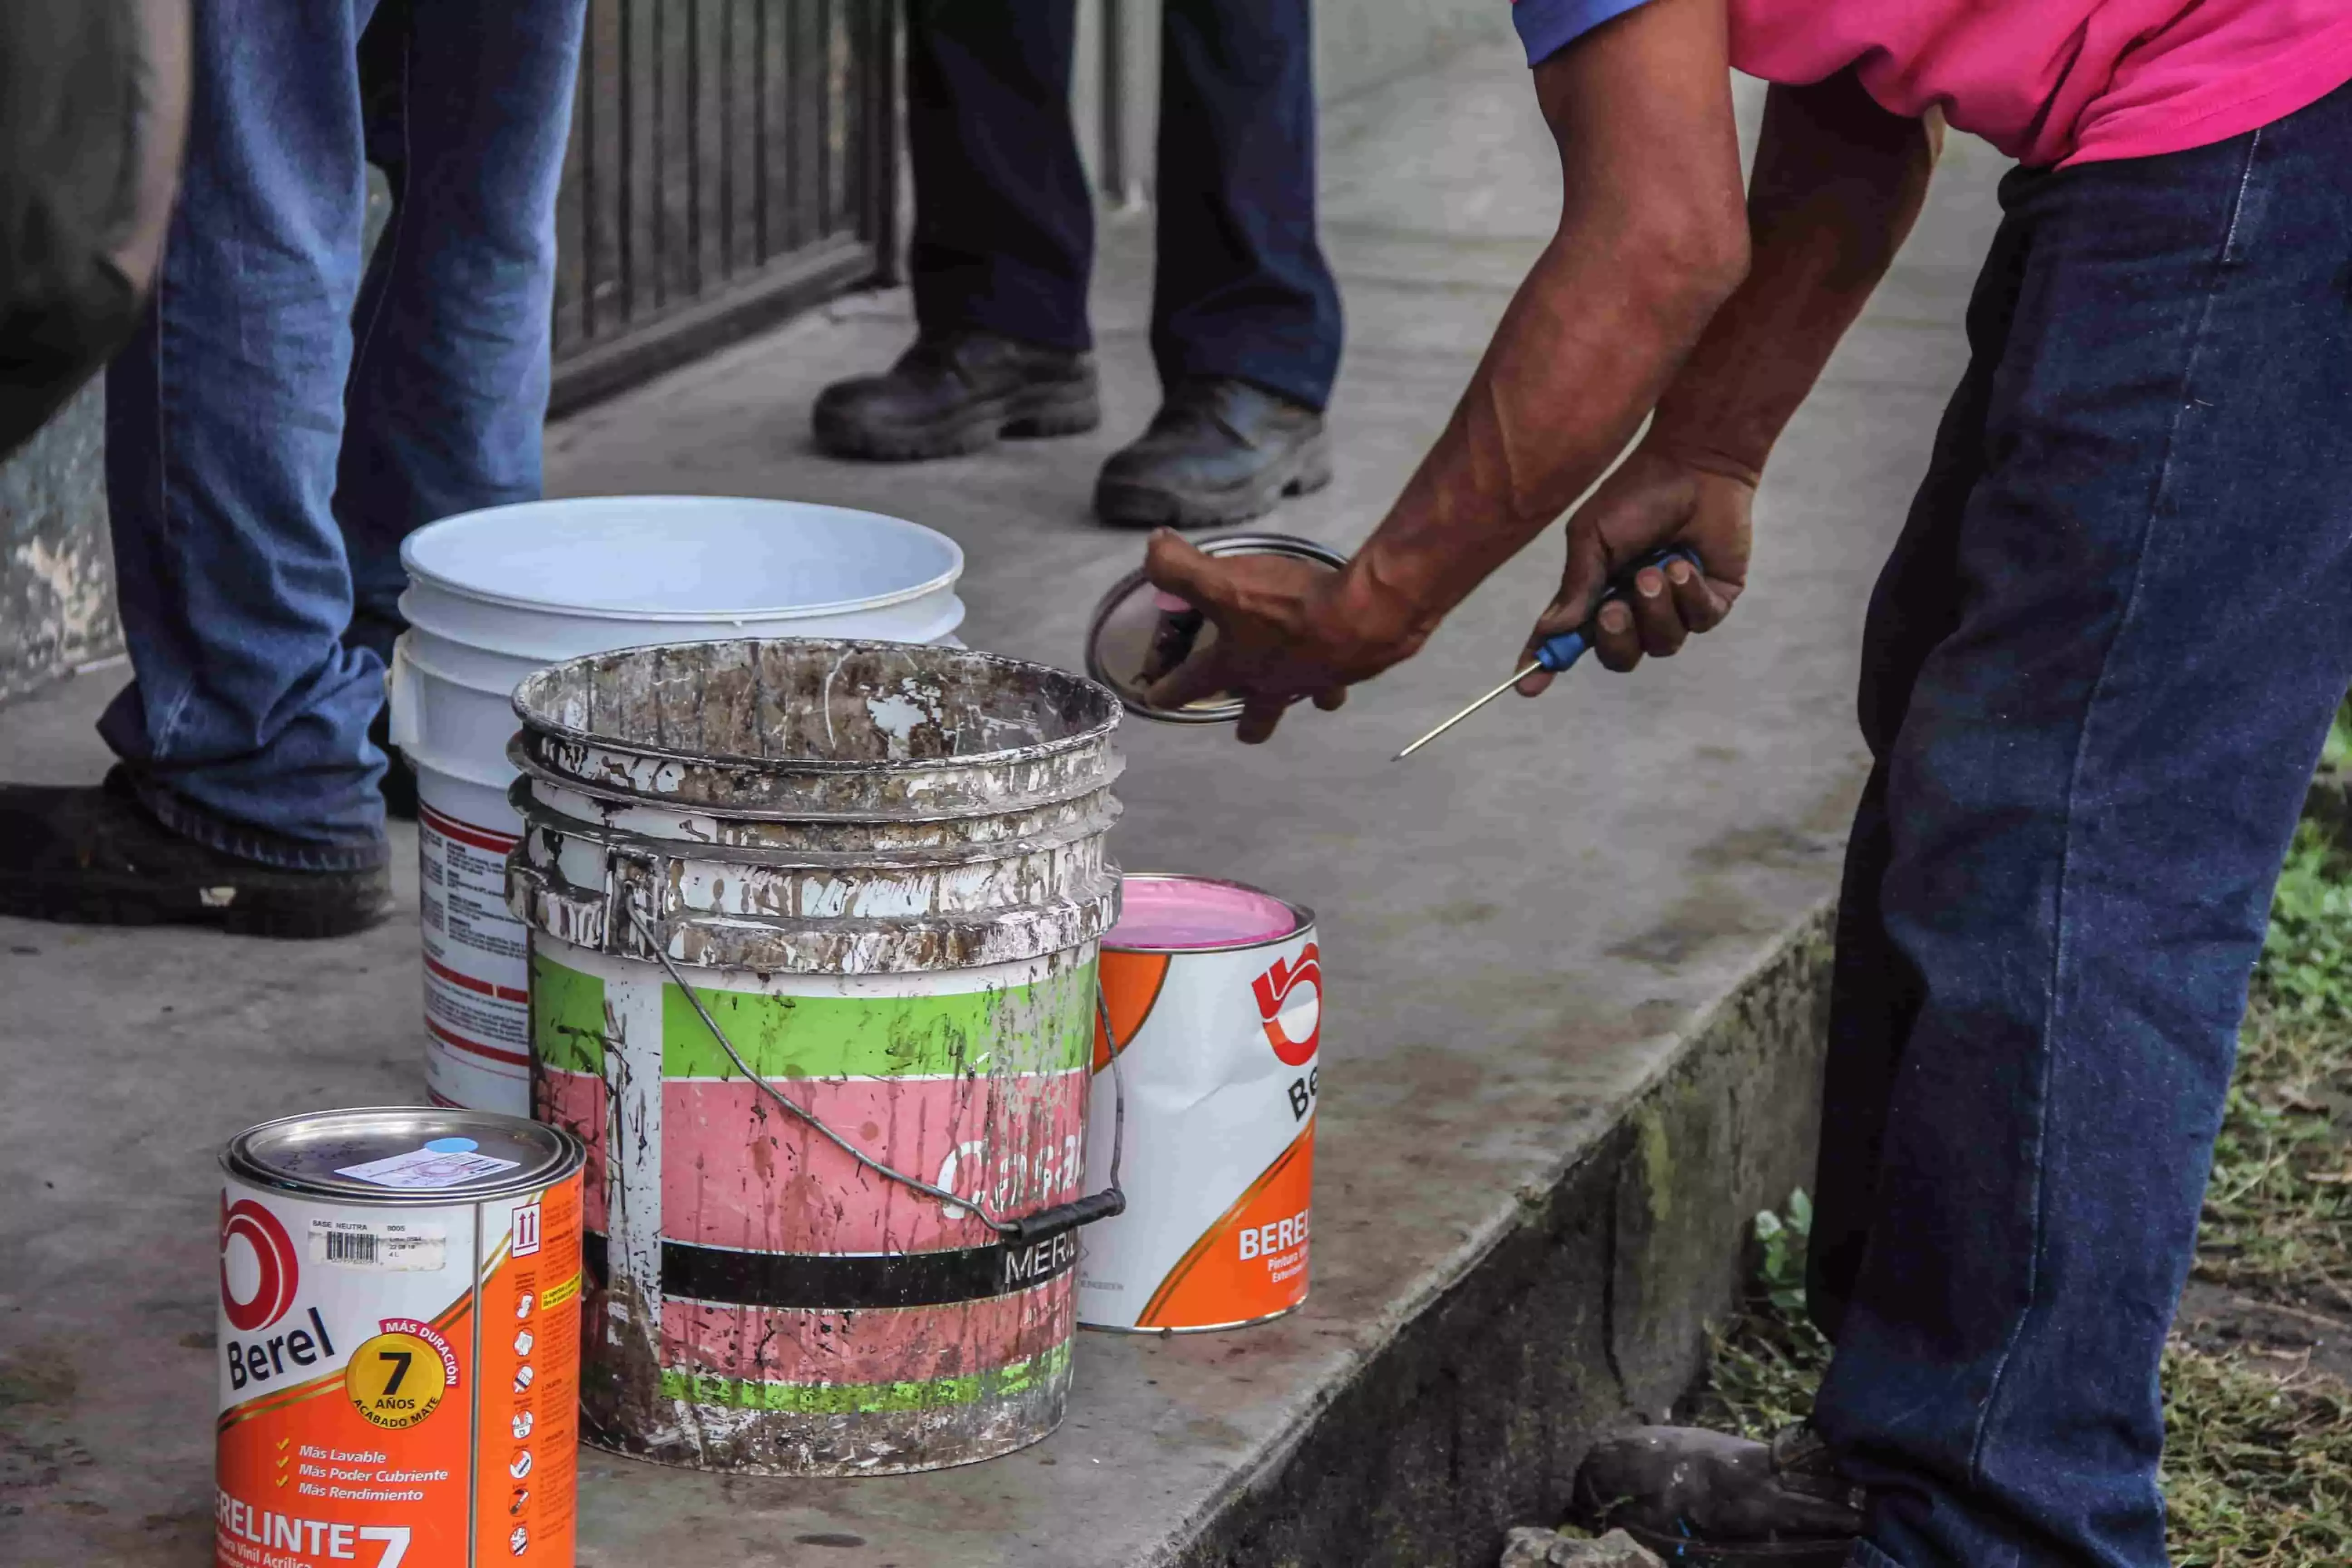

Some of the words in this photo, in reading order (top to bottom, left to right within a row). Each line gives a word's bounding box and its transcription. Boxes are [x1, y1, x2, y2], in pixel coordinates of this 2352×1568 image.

[226, 1306, 335, 1391] Berel
[385, 1321, 417, 1333] MÁS
[419, 1327, 458, 1385] DURACIÓN
[379, 1352, 412, 1395] 7
[354, 1399, 407, 1427] ACABADO
[410, 1397, 438, 1423] MATE
[375, 1397, 415, 1409] AÑOS
[299, 1445, 327, 1459] Más
[330, 1449, 386, 1463] Lavable
[299, 1464, 326, 1478] Más
[330, 1468, 372, 1481] Poder
[376, 1470, 448, 1482] Cubriente
[299, 1482, 326, 1496] Más
[329, 1486, 423, 1501] Rendimiento
[237, 1542, 260, 1563] Vinil
